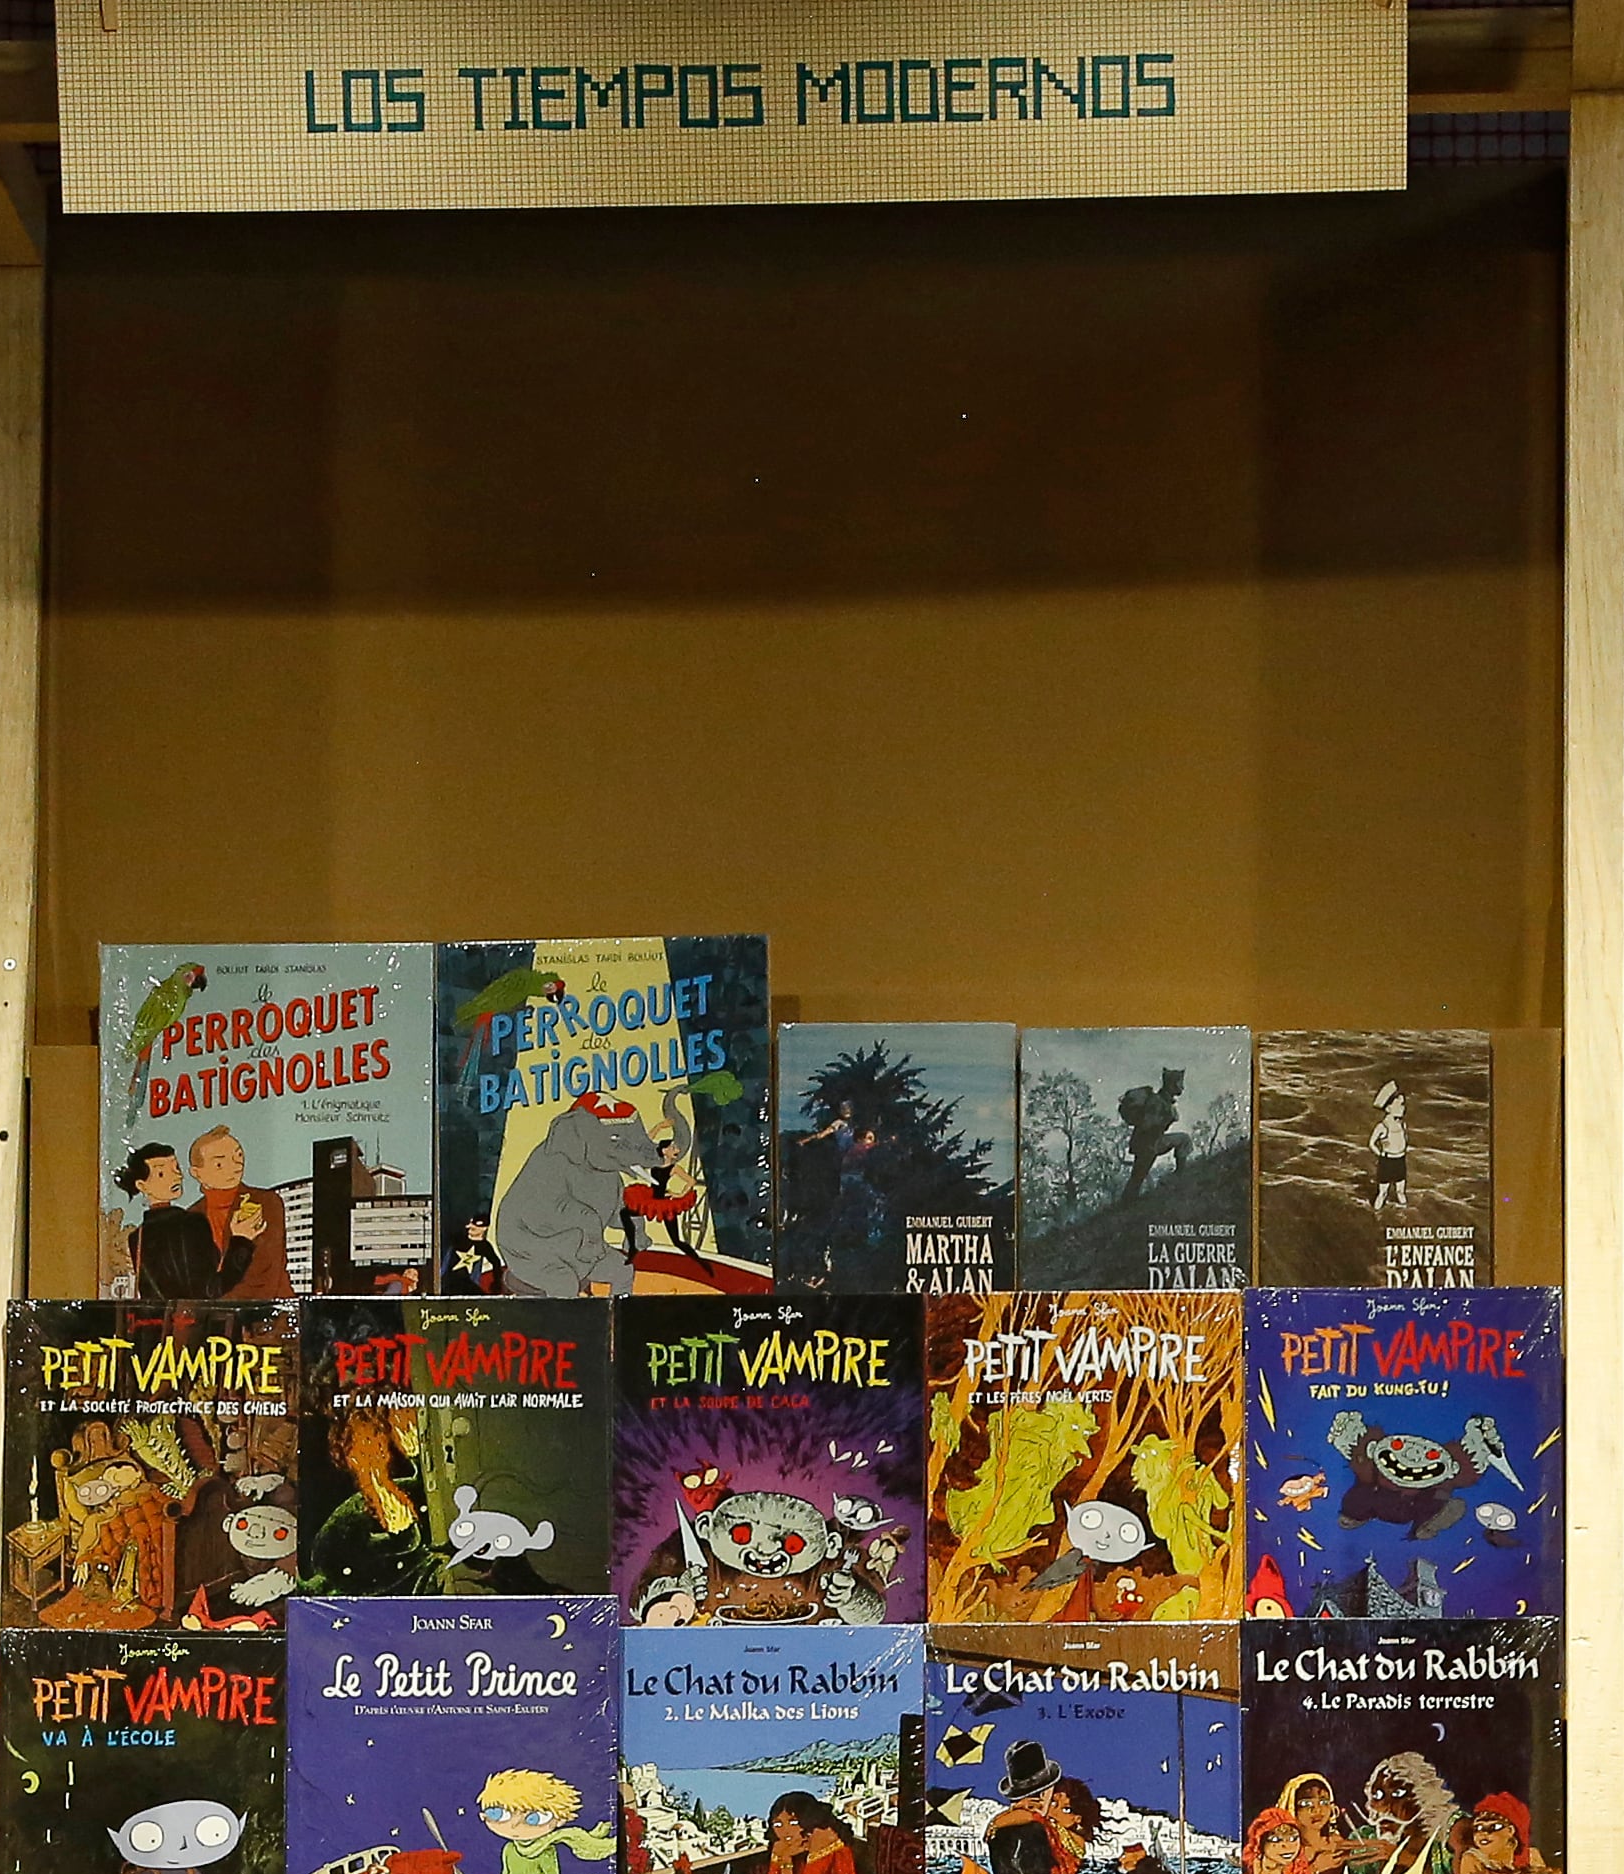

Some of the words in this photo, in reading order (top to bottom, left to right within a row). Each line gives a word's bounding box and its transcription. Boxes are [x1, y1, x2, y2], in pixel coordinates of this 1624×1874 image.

[307, 68, 425, 133] LOS
[460, 63, 763, 131] TIEMPOS
[797, 54, 1176, 125] MODERNOS
[161, 986, 379, 1055] PERROQUET
[490, 975, 713, 1057] PERROQUET
[905, 1233, 993, 1265] MARTHA
[1176, 1242, 1236, 1265] GUERRE
[1386, 1245, 1474, 1267] L'ENFANCE
[41, 1338, 133, 1390] PETIT
[133, 1336, 282, 1394] VAMPIRE
[523, 1394, 582, 1408] NORMALE
[411, 1615, 448, 1631] JOANN
[455, 1617, 493, 1631] SFAR
[323, 1654, 363, 1699] Le
[374, 1652, 449, 1698] Petit
[465, 1653, 577, 1698] Prince
[1295, 1649, 1369, 1680] Chat
[1376, 1650, 1417, 1680] du
[1425, 1647, 1539, 1680] Rabbin
[709, 1703, 769, 1721] Malka
[775, 1705, 805, 1721] des
[810, 1703, 859, 1720] Lions
[1348, 1694, 1411, 1710] Paradis
[1419, 1693, 1495, 1709] terrestre
[107, 1726, 176, 1747] L'ÉCOLE
